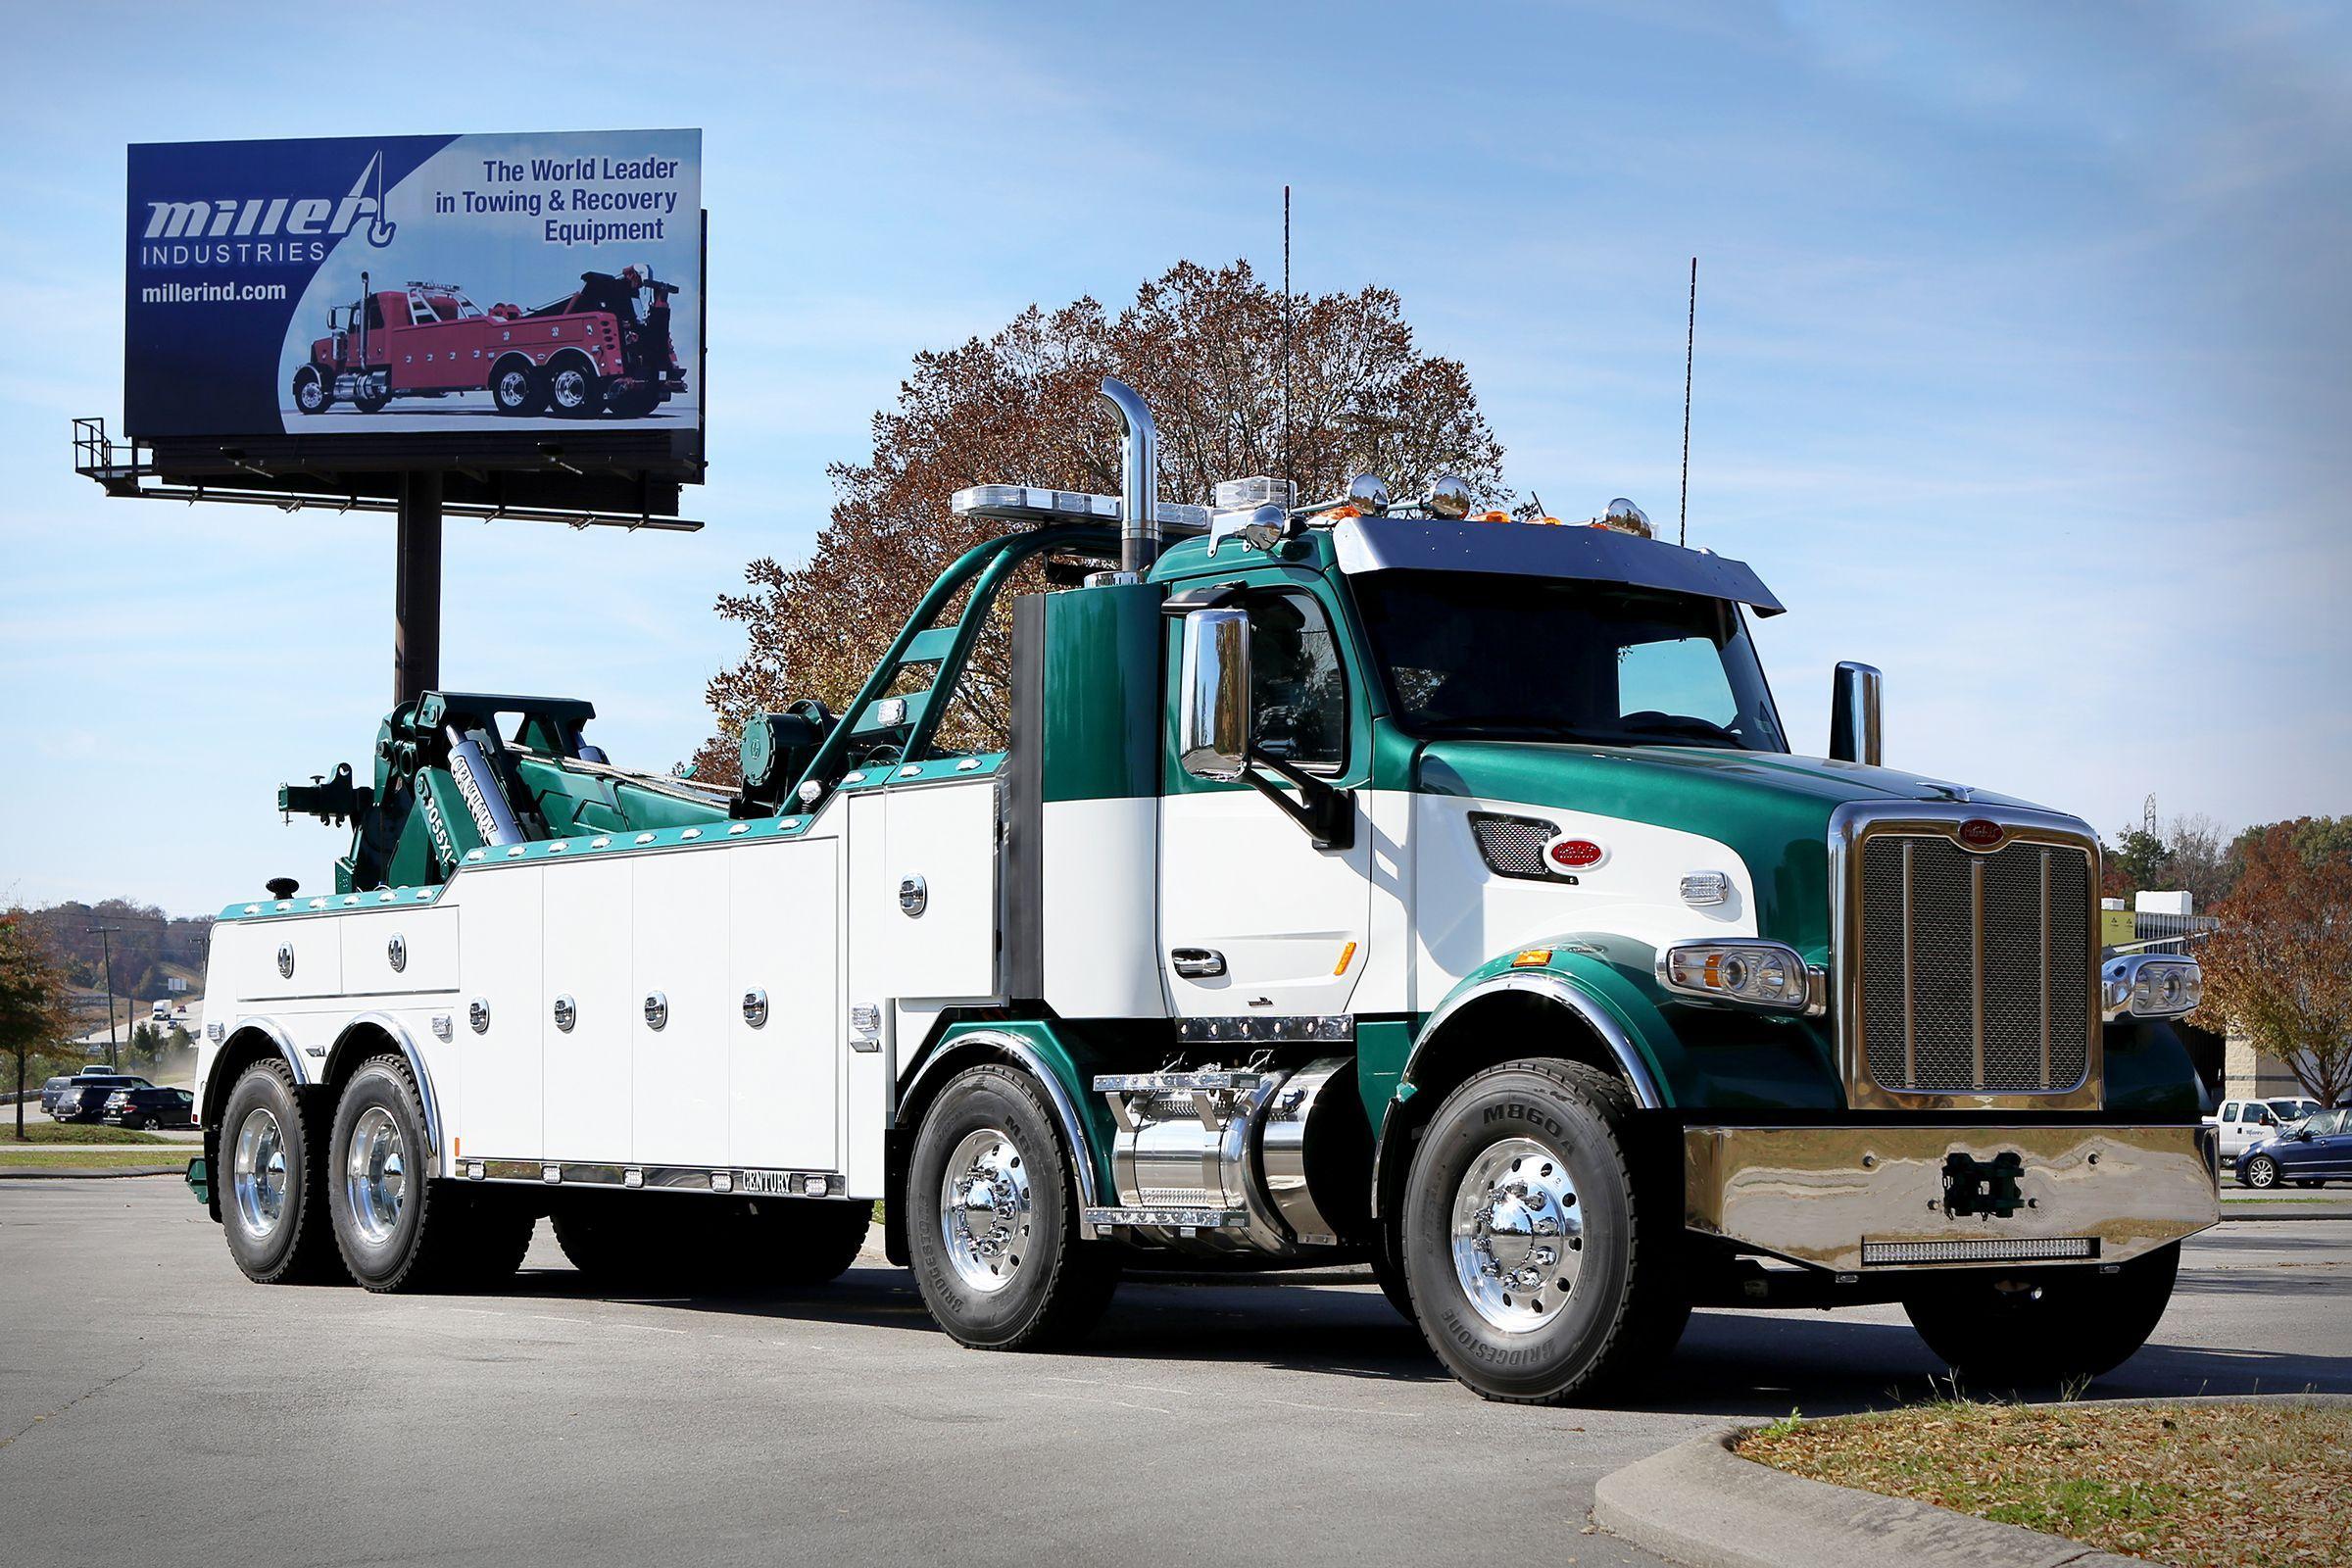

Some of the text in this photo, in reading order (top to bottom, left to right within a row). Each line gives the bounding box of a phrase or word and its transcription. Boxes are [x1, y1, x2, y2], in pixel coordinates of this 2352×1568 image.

[483, 157, 678, 182] The World Leader
[435, 189, 677, 216] in Towing & Recovery
[144, 195, 378, 238] miller
[545, 219, 663, 245] Equipment
[142, 242, 324, 265] INDUSTRIES
[142, 282, 286, 303] millerind.com
[743, 1170, 792, 1193] CENTURY
[1441, 1307, 1558, 1366] BRIDGESTONE
